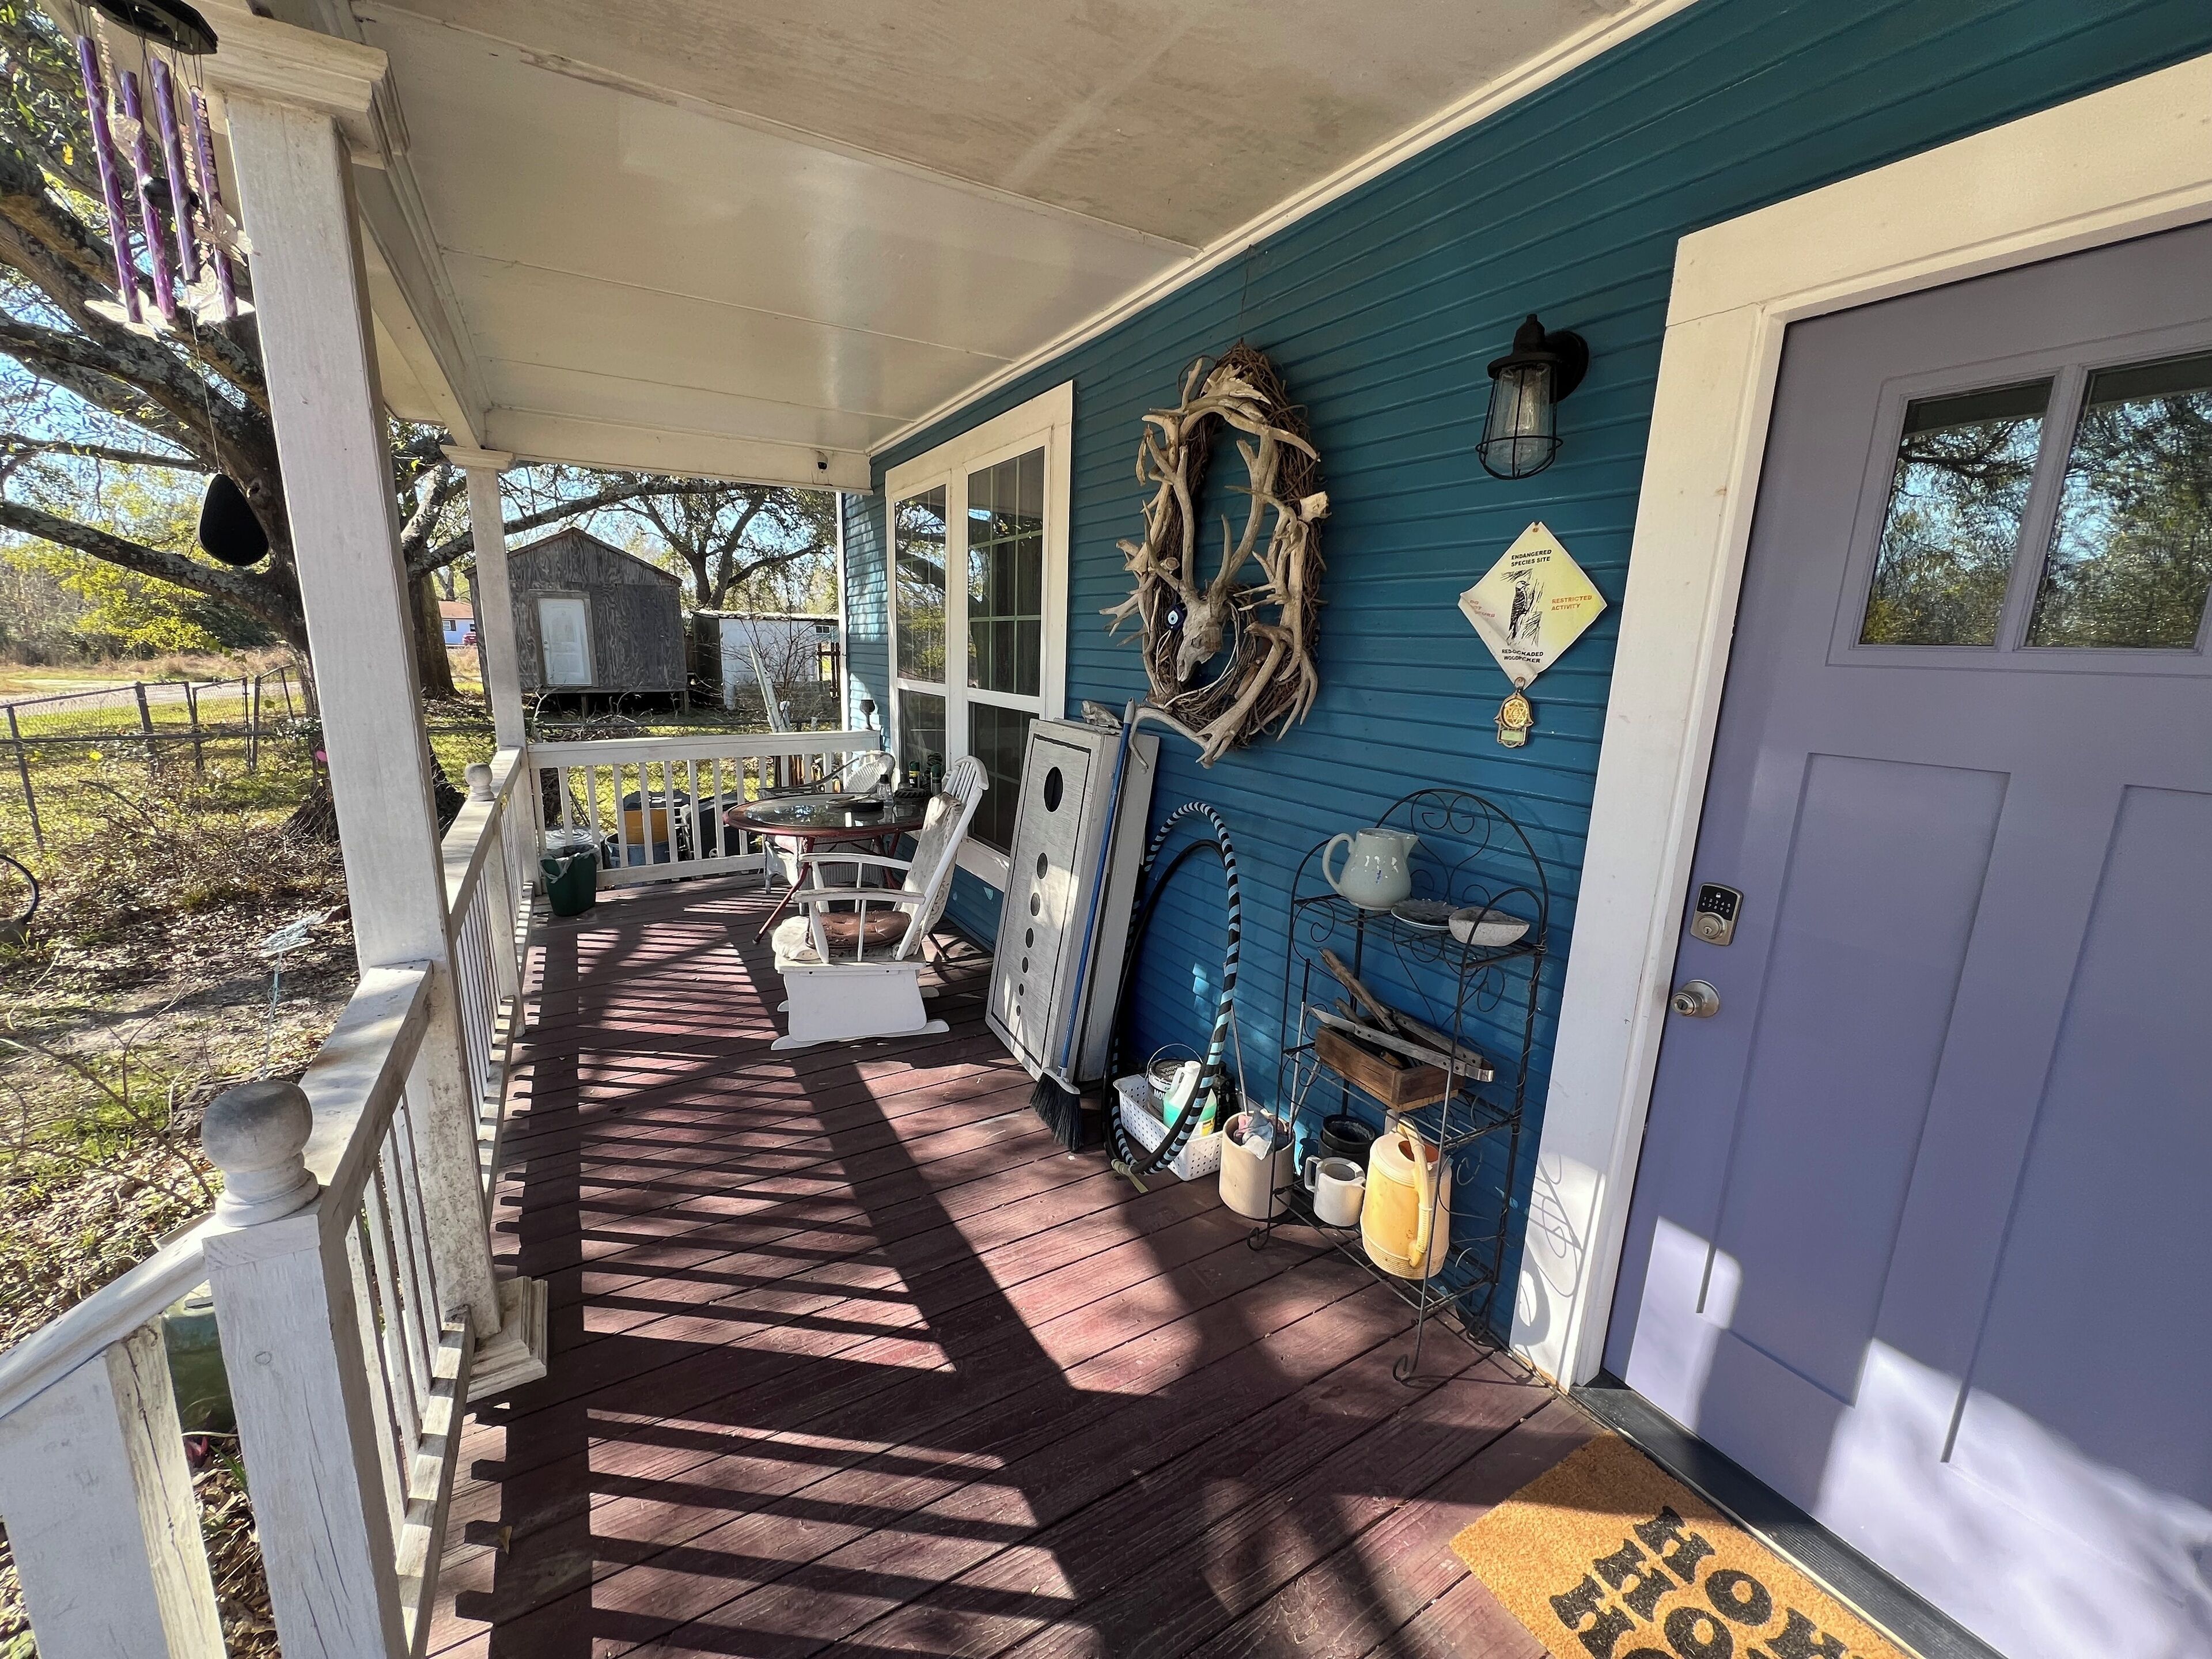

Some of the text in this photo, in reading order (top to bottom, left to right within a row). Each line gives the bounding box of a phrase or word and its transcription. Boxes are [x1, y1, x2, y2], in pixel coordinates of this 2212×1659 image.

[1512, 550, 1552, 560] ENDANGERED
[1511, 559, 1535, 567] SPECIES
[1552, 595, 1592, 604] RESTRICTED
